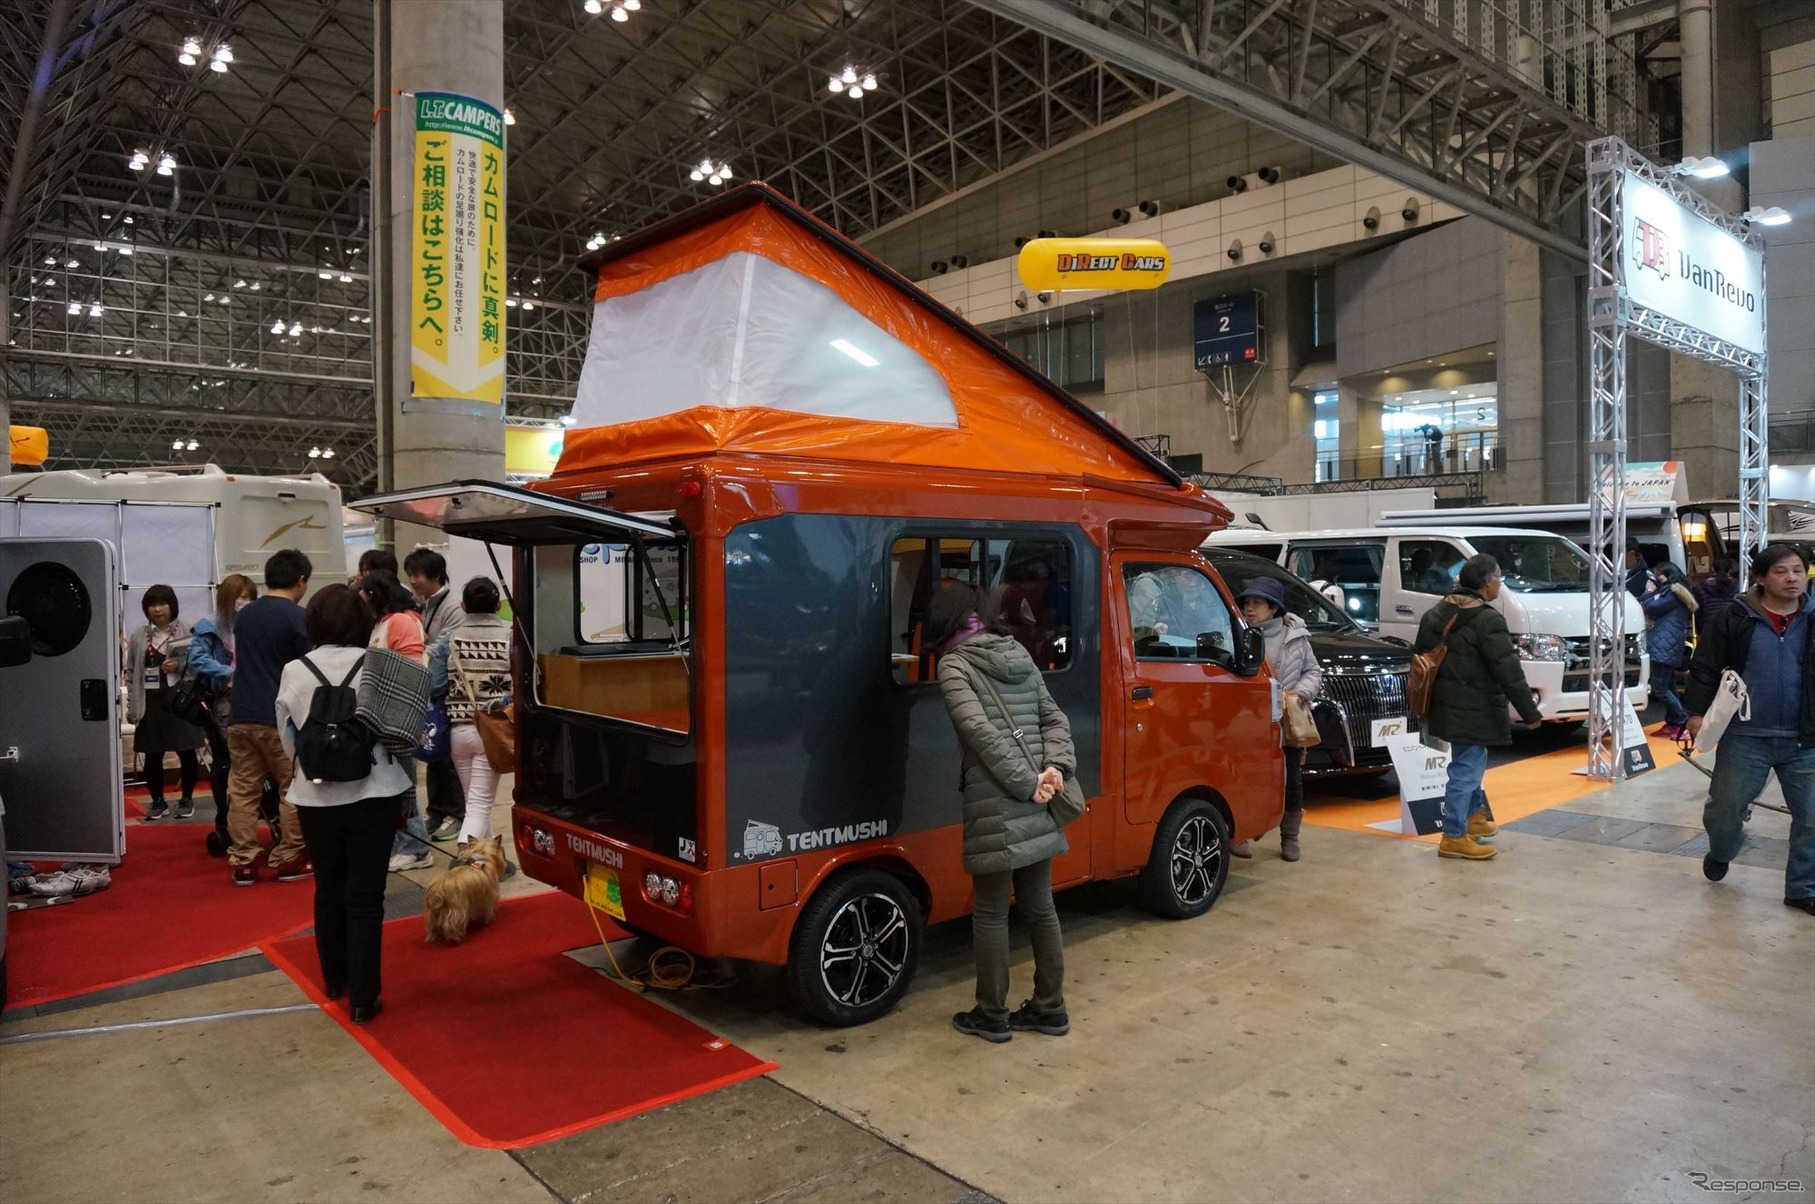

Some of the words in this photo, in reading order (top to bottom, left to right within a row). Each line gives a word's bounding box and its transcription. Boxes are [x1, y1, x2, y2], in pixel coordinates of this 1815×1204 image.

[419, 140, 447, 346] ご相談はこちらへ。
[483, 153, 499, 354] カムロードに真剣。
[1219, 316, 1230, 332] 2
[566, 833, 623, 869] TENTMUSHI
[787, 819, 888, 851] TENTMUSHI
